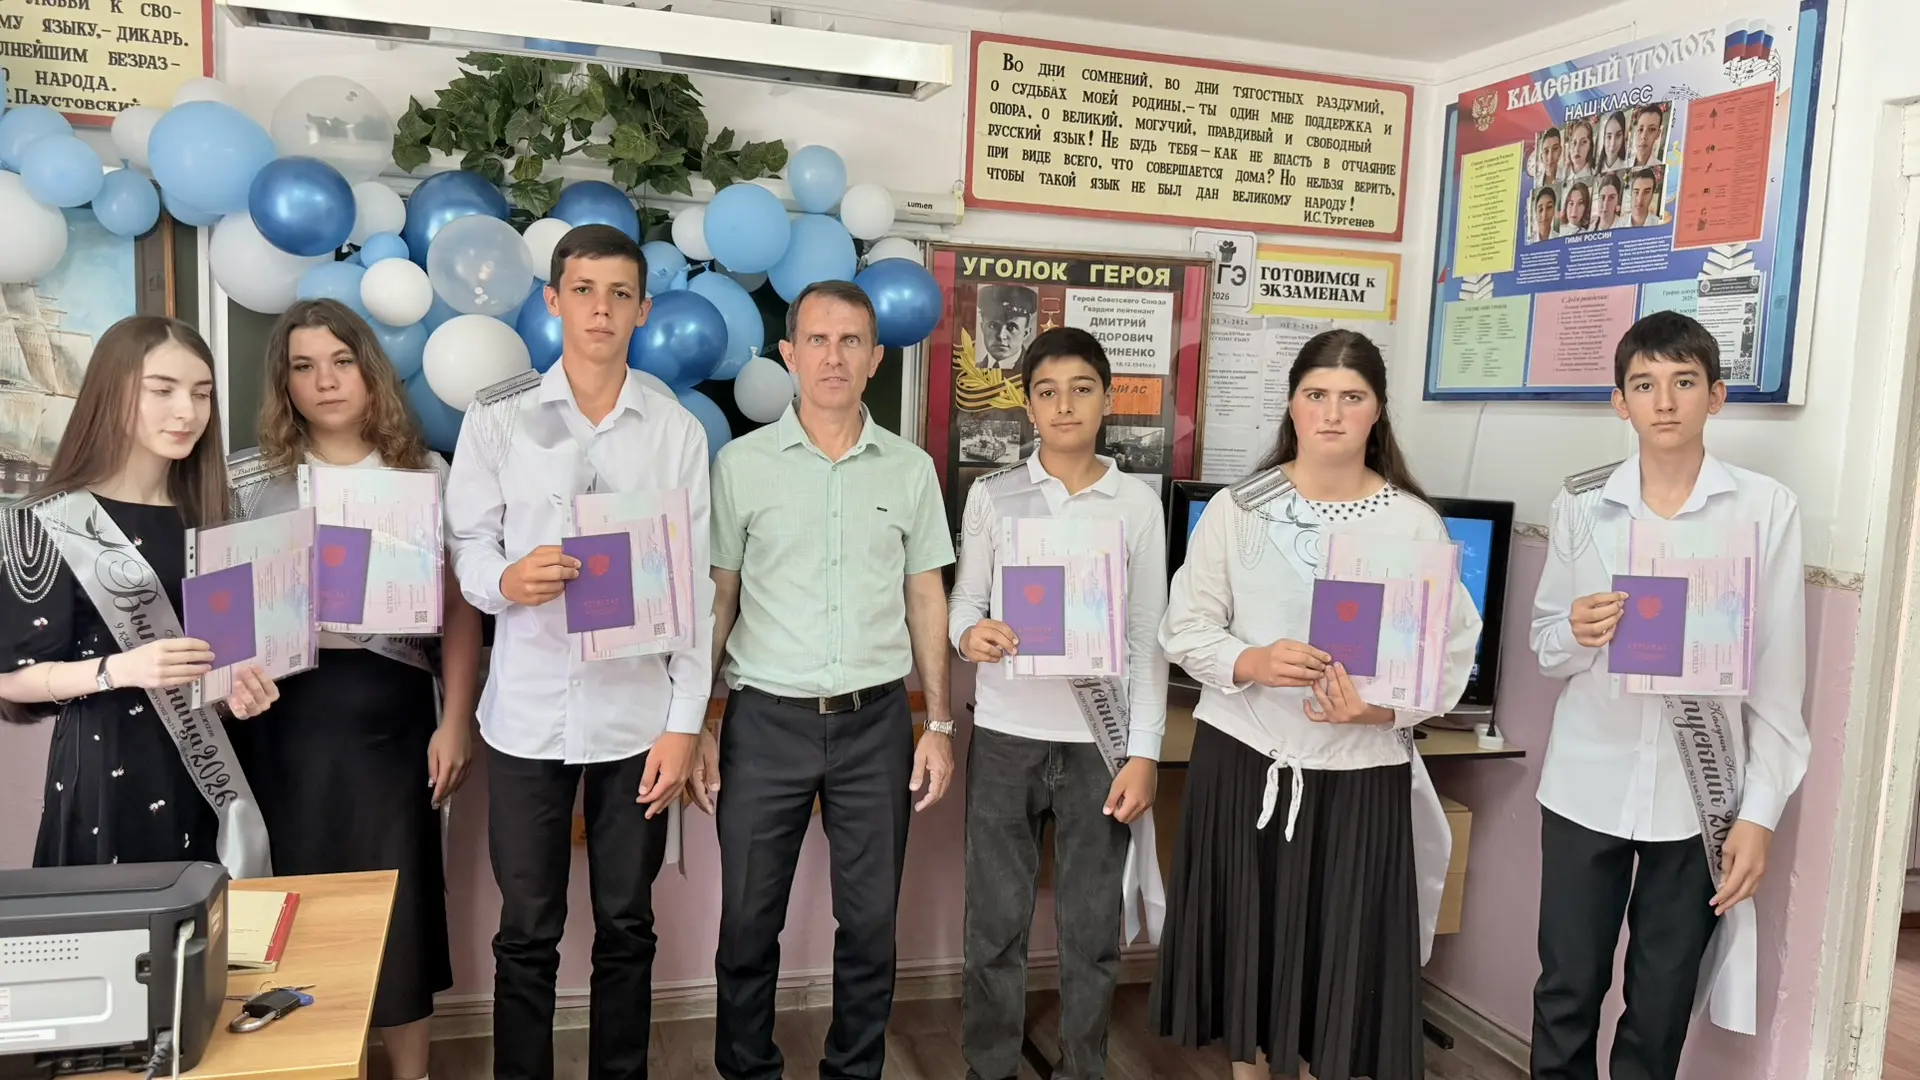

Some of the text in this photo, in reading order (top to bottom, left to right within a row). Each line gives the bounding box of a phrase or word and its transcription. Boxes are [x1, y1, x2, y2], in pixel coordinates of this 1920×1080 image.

[110, 0, 124, 14] К
[140, 2, 182, 19] СВО-
[0, 15, 24, 30] МУ
[116, 26, 189, 47] ДИКАРЬ.
[0, 39, 181, 71] ЛНЕЙШИМ БЕЗРАЗ-
[35, 70, 117, 92] НАРОДА.
[1506, 28, 1716, 111] КЛАССНЫЙ УГОЛОК
[1037, 63, 1065, 78] ДНИ
[1081, 68, 1153, 89] СОМНЕНИЙ,
[1164, 77, 1180, 91] ВО
[1194, 81, 1220, 95] ДНИ
[1233, 85, 1304, 105] ТЯГОСТНЫХ
[1316, 96, 1384, 116] РАЗДУМИЙ,
[990, 80, 999, 91] О
[1012, 82, 1067, 100] СУДЬБАХ
[1082, 88, 1118, 106] МОЕЙ
[1230, 107, 1260, 122] ОДИН
[1270, 111, 1294, 125] МНЕ
[1304, 115, 1372, 134] ПОДДЕРЖКА
[1383, 124, 1392, 136] И
[1564, 84, 1653, 122] НАШ КЛАСС
[990, 101, 1372, 153] ОПОРА, О ВЕЛИКИЙ, МОГУЧИЙ, ПРАВДИВЫЙ И СВОБОДНЫЙ
[987, 123, 1041, 141] РУССКИЙ
[1053, 130, 1094, 146] ЯЗЫК!
[1129, 138, 1157, 154] БУДЬ
[1168, 141, 1198, 157] ТЕБЯ
[1214, 146, 1238, 160] КАК
[1249, 150, 1263, 164] НЕ
[1273, 154, 1313, 168] ВПАСТЬ
[1323, 158, 1330, 169] В
[1341, 160, 1397, 176] ОТЧАЯНИЕ
[987, 145, 1009, 160] ПРИ
[1021, 149, 1051, 164] ВИДЕ
[1063, 154, 1102, 170] ВСЕГО,
[1111, 158, 1133, 171] ЧТО
[1146, 161, 1223, 180] СОВЕРШАЕТСЯ
[1235, 168, 1275, 184] ДОМА?
[1306, 176, 1344, 191] НЕЛЬЗЯ
[1354, 180, 1396, 197] ВЕРИТЬ,
[986, 167, 1355, 212] ЧТОБЫ ТАКОЙ ЯЗЫК НЕ БЫЛ ДАН ВЕЛИКОМУ НАРОДУ!
[1583, 231, 1612, 242] РОССИИ
[962, 256, 1171, 286] УГОЛОК ГЕРОЯ
[1216, 264, 1247, 287] ГЭ
[1260, 266, 1360, 287] ГОТОВИМСЯ
[1072, 295, 1095, 303] Герой
[1097, 296, 1139, 304] Советского
[1259, 283, 1366, 303] ЭКЗАМЕНАМ
[1083, 305, 1155, 315] Гвардии лейтенант
[1089, 317, 1147, 328] ДМИТРИЙ
[1091, 331, 1153, 343] ЁДОРОВИЧ
[1103, 347, 1156, 358] РИНЕНКО
[1130, 385, 1148, 394] АС
[1672, 695, 1726, 808] пускник
